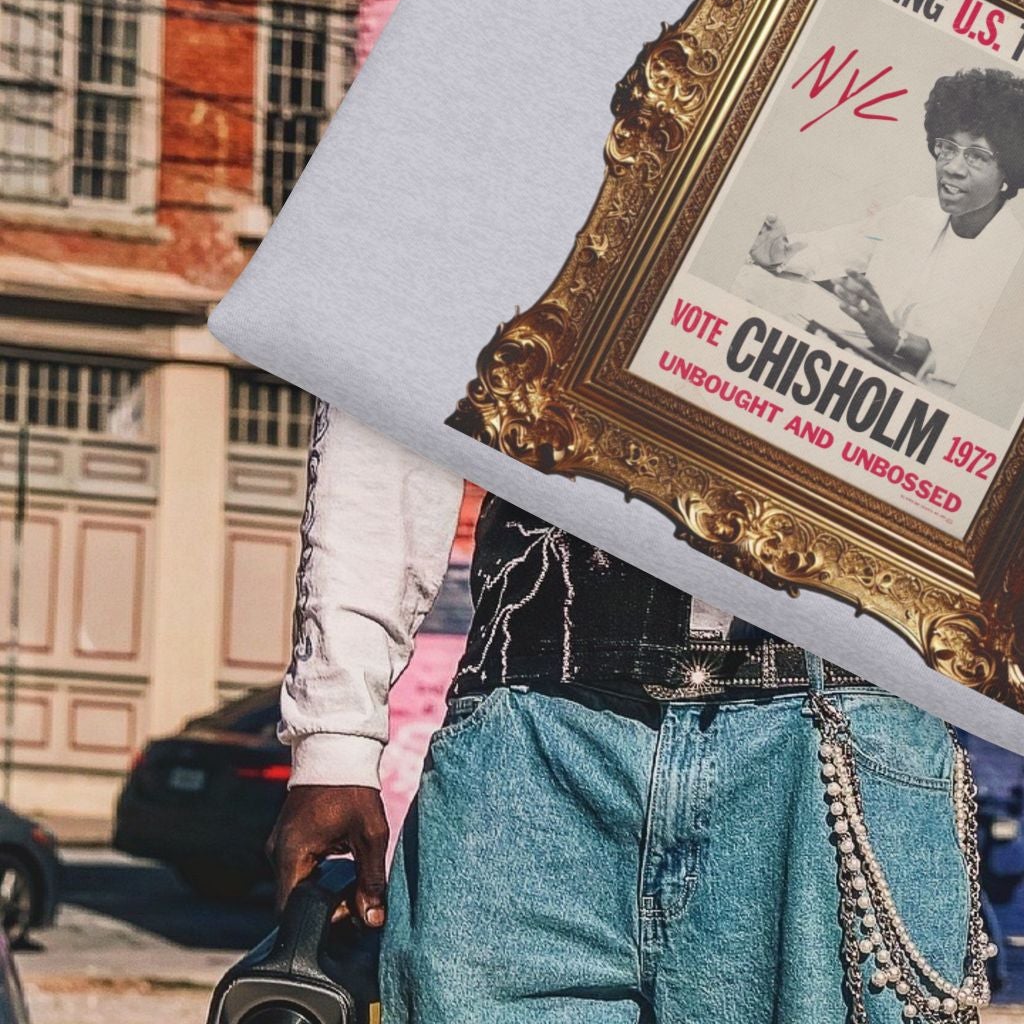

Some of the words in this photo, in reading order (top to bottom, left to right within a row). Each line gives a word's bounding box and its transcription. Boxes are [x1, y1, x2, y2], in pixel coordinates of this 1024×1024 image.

[792, 45, 908, 132] NYC
[658, 350, 784, 423] UNBOUGHT
[784, 415, 835, 450] AND
[841, 441, 962, 514] UNBOSSED
[671, 298, 729, 347] VOTE
[726, 316, 950, 465] CHISHOLM
[943, 436, 997, 481] 1972
